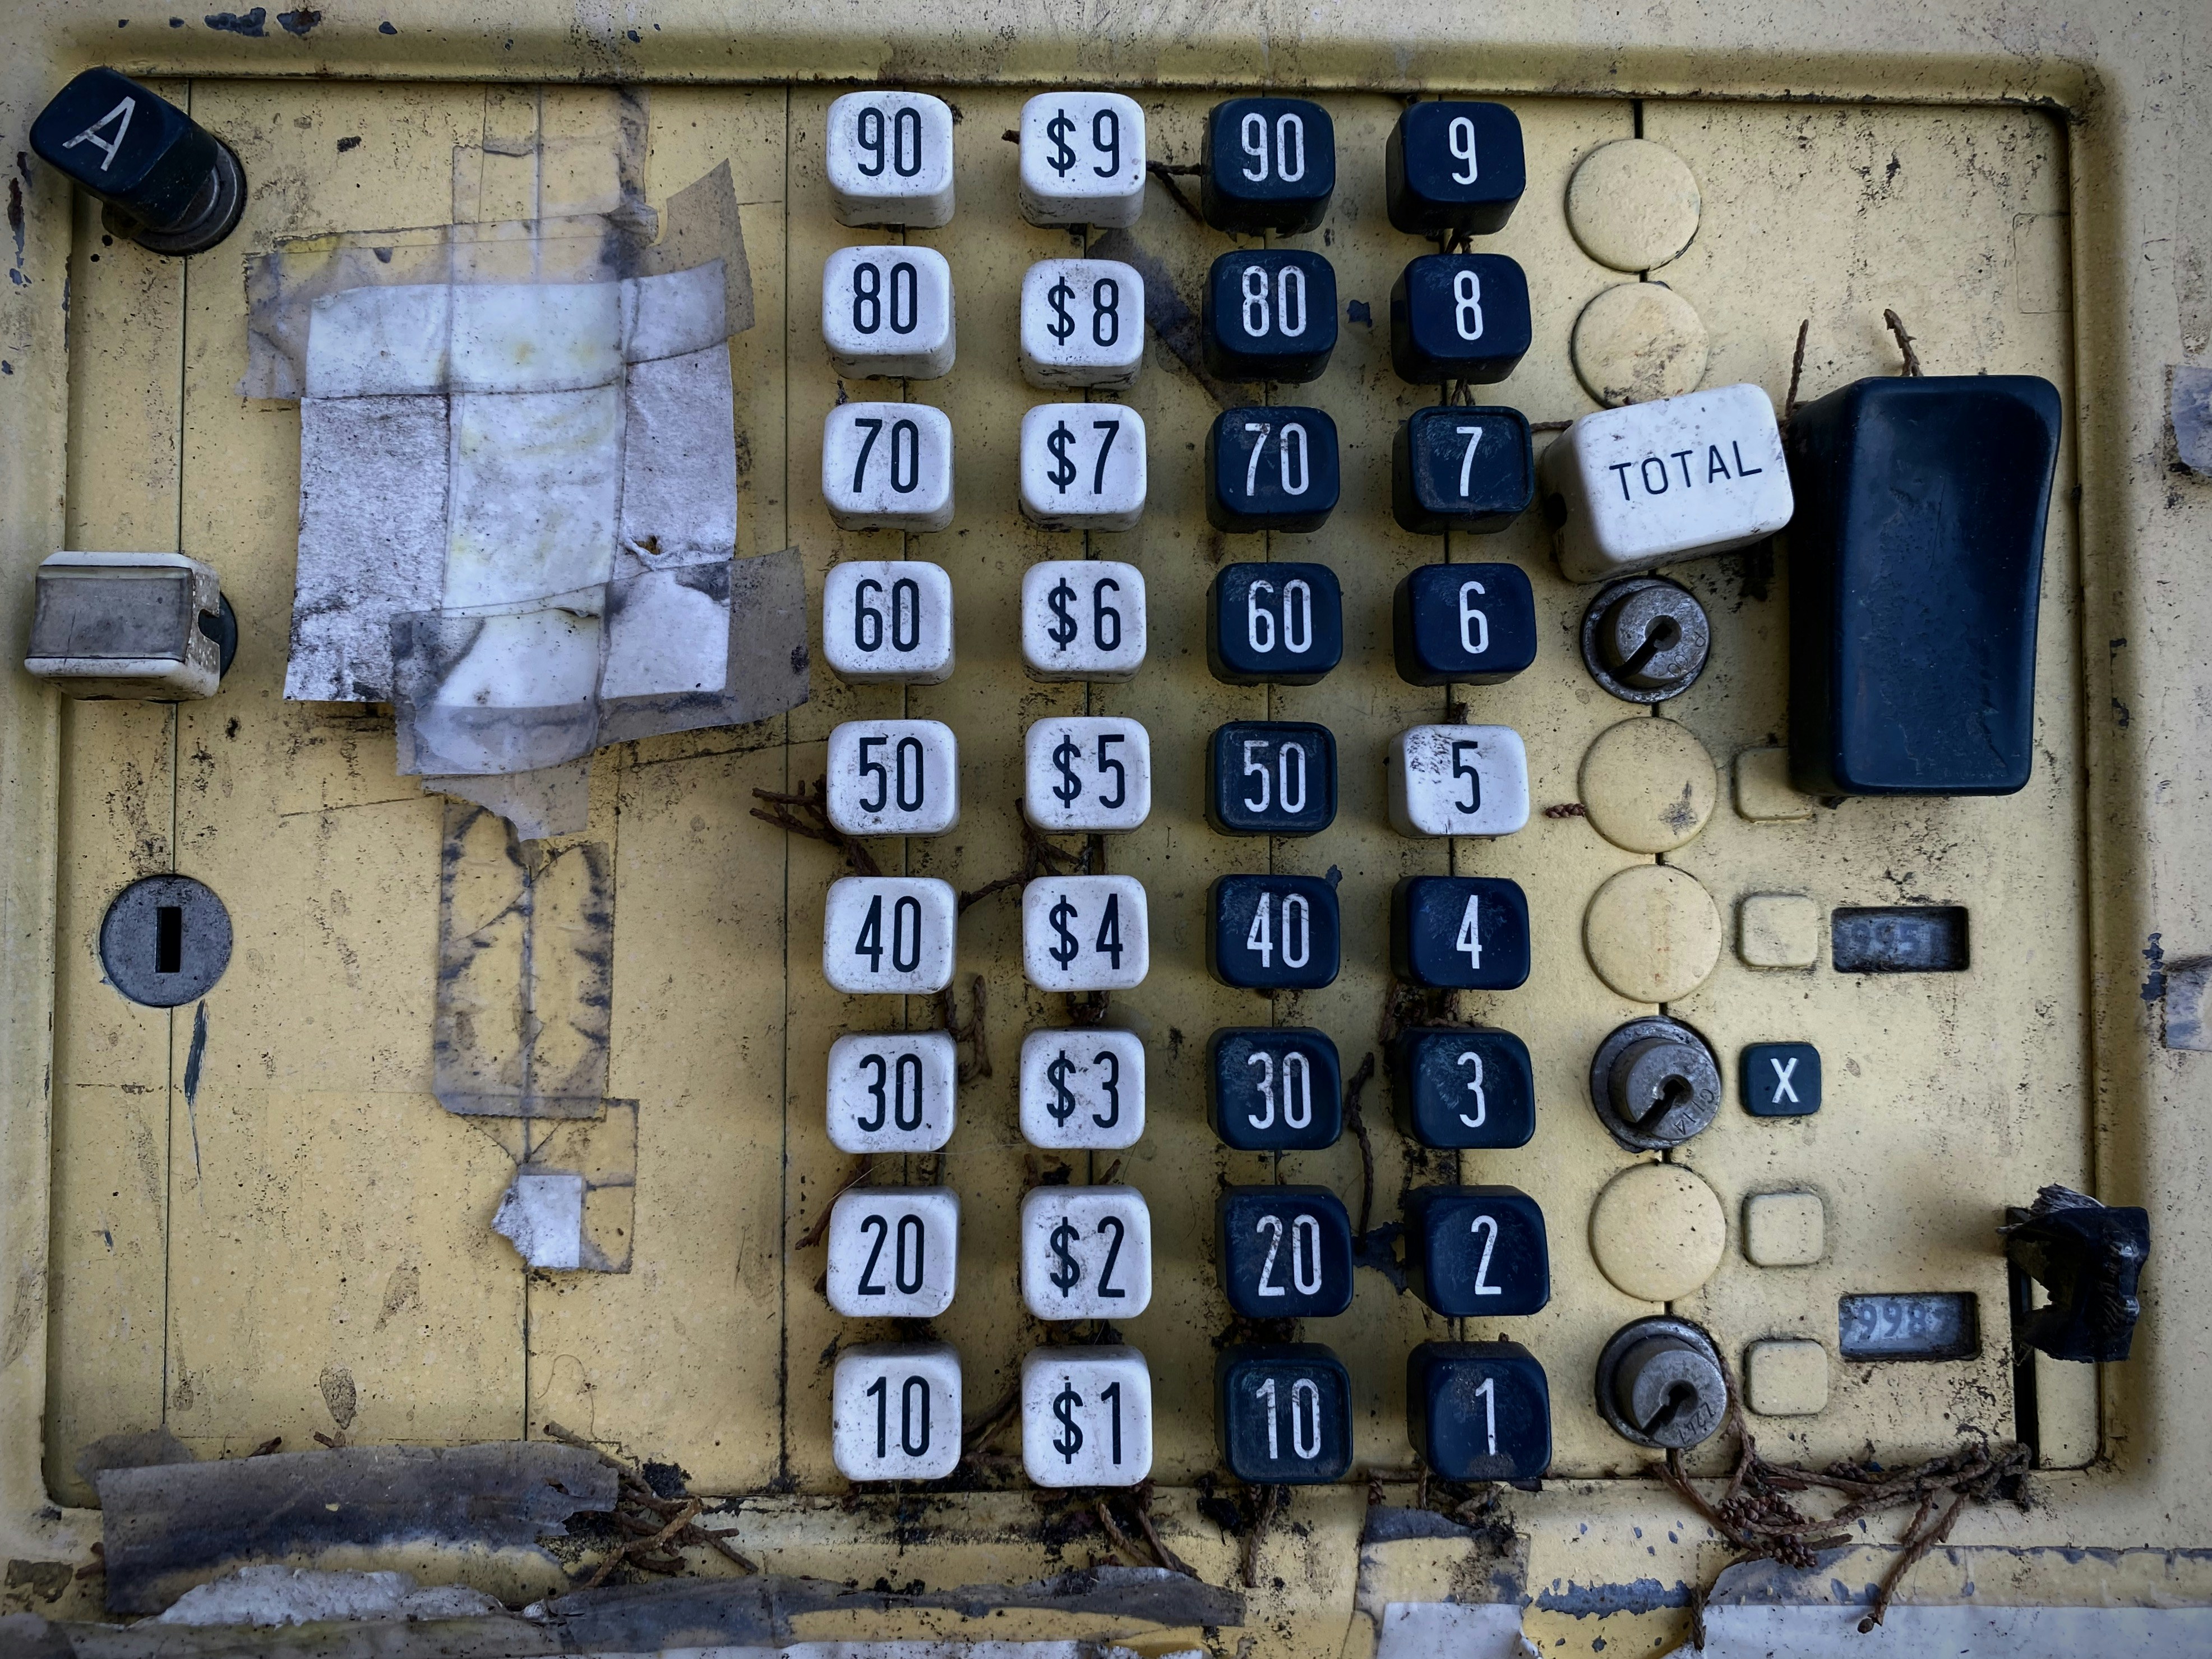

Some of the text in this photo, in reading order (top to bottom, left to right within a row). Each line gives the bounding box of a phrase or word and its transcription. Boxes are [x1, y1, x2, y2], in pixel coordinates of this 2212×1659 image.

[62, 96, 136, 171] A
[858, 107, 923, 177] 90
[1047, 107, 1119, 178] $9
[1242, 113, 1304, 182] 90
[1449, 117, 1477, 185] 9
[853, 262, 917, 334] 80
[1047, 276, 1119, 347] $8
[1243, 266, 1306, 337] 80
[1454, 270, 1483, 340] 8
[853, 418, 919, 493] 70
[1047, 420, 1119, 494] $7
[1247, 423, 1308, 495] 70
[1457, 427, 1483, 496] 7
[1609, 440, 1763, 501] TOTAL
[855, 577, 920, 652] 60
[1048, 578, 1121, 652] $6
[1249, 580, 1312, 653] 60
[1460, 582, 1488, 653] 6
[859, 733, 923, 813] 50
[1052, 734, 1125, 809] $5
[1244, 744, 1305, 813] 50
[1452, 740, 1480, 814] 5
[855, 895, 921, 973] 40
[1049, 893, 1123, 970] $4
[1247, 893, 1309, 967] 40
[1457, 895, 1482, 969] 4
[858, 1053, 924, 1132] 30
[1047, 1049, 1119, 1128] $3
[1248, 1052, 1311, 1128] 30
[1458, 1052, 1485, 1127] 3
[1770, 1057, 1799, 1103] X
[858, 1214, 924, 1295] 20
[1050, 1216, 1125, 1298] $2
[1259, 1215, 1321, 1296] 20
[1471, 1216, 1501, 1294] 2
[867, 1375, 930, 1458] 10
[1053, 1382, 1121, 1464] $1
[1255, 1379, 1320, 1458] 10
[1476, 1379, 1495, 1455] 1
